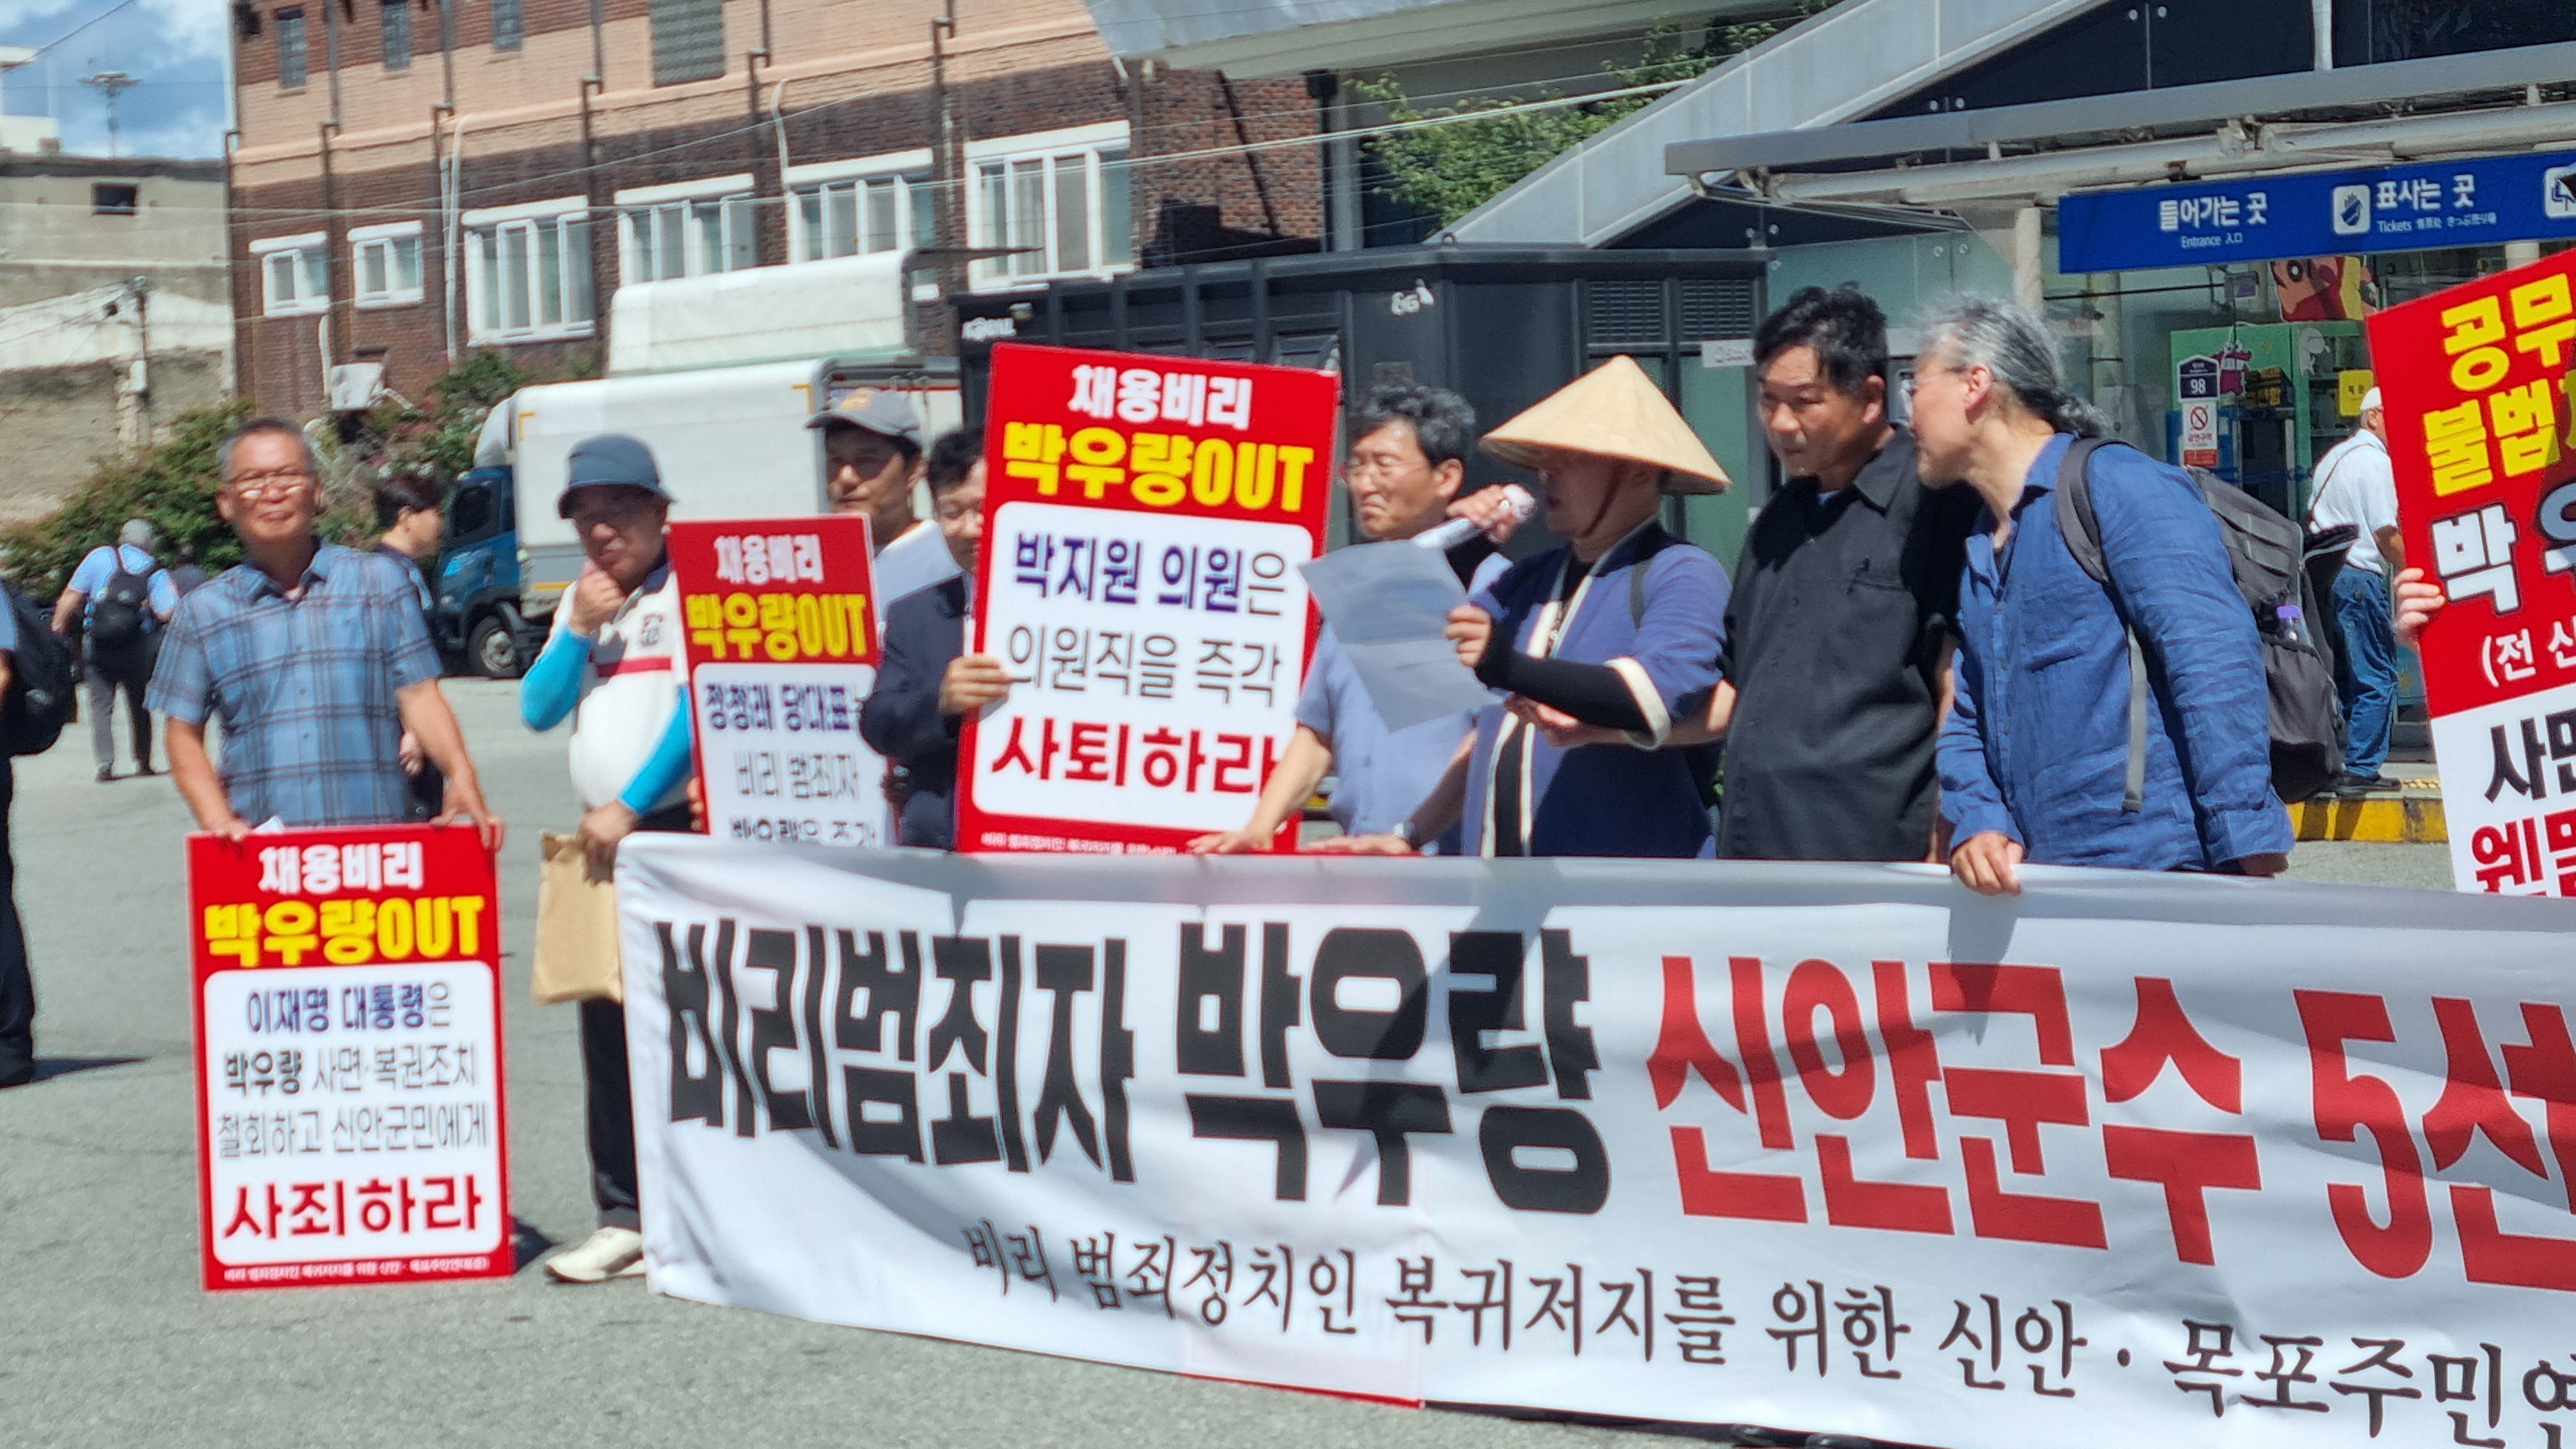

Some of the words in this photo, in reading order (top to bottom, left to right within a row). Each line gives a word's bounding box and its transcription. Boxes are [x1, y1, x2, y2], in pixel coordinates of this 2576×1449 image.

[2159, 195, 2240, 231] 들어가는
[2246, 192, 2267, 225] 곳
[2376, 178, 2441, 211] 표사는
[2452, 174, 2476, 209] 곳
[2181, 235, 2221, 249] Entrance
[2225, 233, 2243, 245] 入口
[2377, 220, 2412, 233] Tickets
[1068, 364, 1253, 429] 채용비리
[2190, 378, 2206, 395] 98
[1002, 422, 1314, 511] 박우량OUT
[714, 533, 824, 585] 채용비리
[1015, 532, 1142, 605] 박지원
[1156, 547, 1287, 617] 의원은
[685, 592, 867, 660] 박우량OUT
[1008, 624, 1177, 699] 의원직을
[1195, 638, 1281, 709] 즉각
[2481, 627, 2537, 687] (전
[781, 684, 862, 732] 당대표
[991, 717, 1281, 797] 사퇴하라
[259, 841, 424, 894] 채용비리
[204, 896, 484, 967] 박우량OUT
[247, 987, 329, 1033] 이재명
[341, 980, 450, 1033] 대통령은
[225, 1048, 303, 1096] 박우량
[654, 917, 1137, 1183] 비리범죄자
[1176, 922, 1611, 1215] 박우량
[1646, 954, 2262, 1267] 신안군수
[217, 1109, 321, 1159] 철회하고
[332, 1100, 489, 1152] 신안군민에게
[223, 1173, 483, 1240] 사죄하라
[962, 1219, 1059, 1303] 비리
[1070, 1229, 1358, 1335] 범죄정치인
[1384, 1255, 1736, 1365] 복귀저지를
[1765, 1278, 1912, 1381] 위한
[1938, 1293, 2089, 1399] 신안
